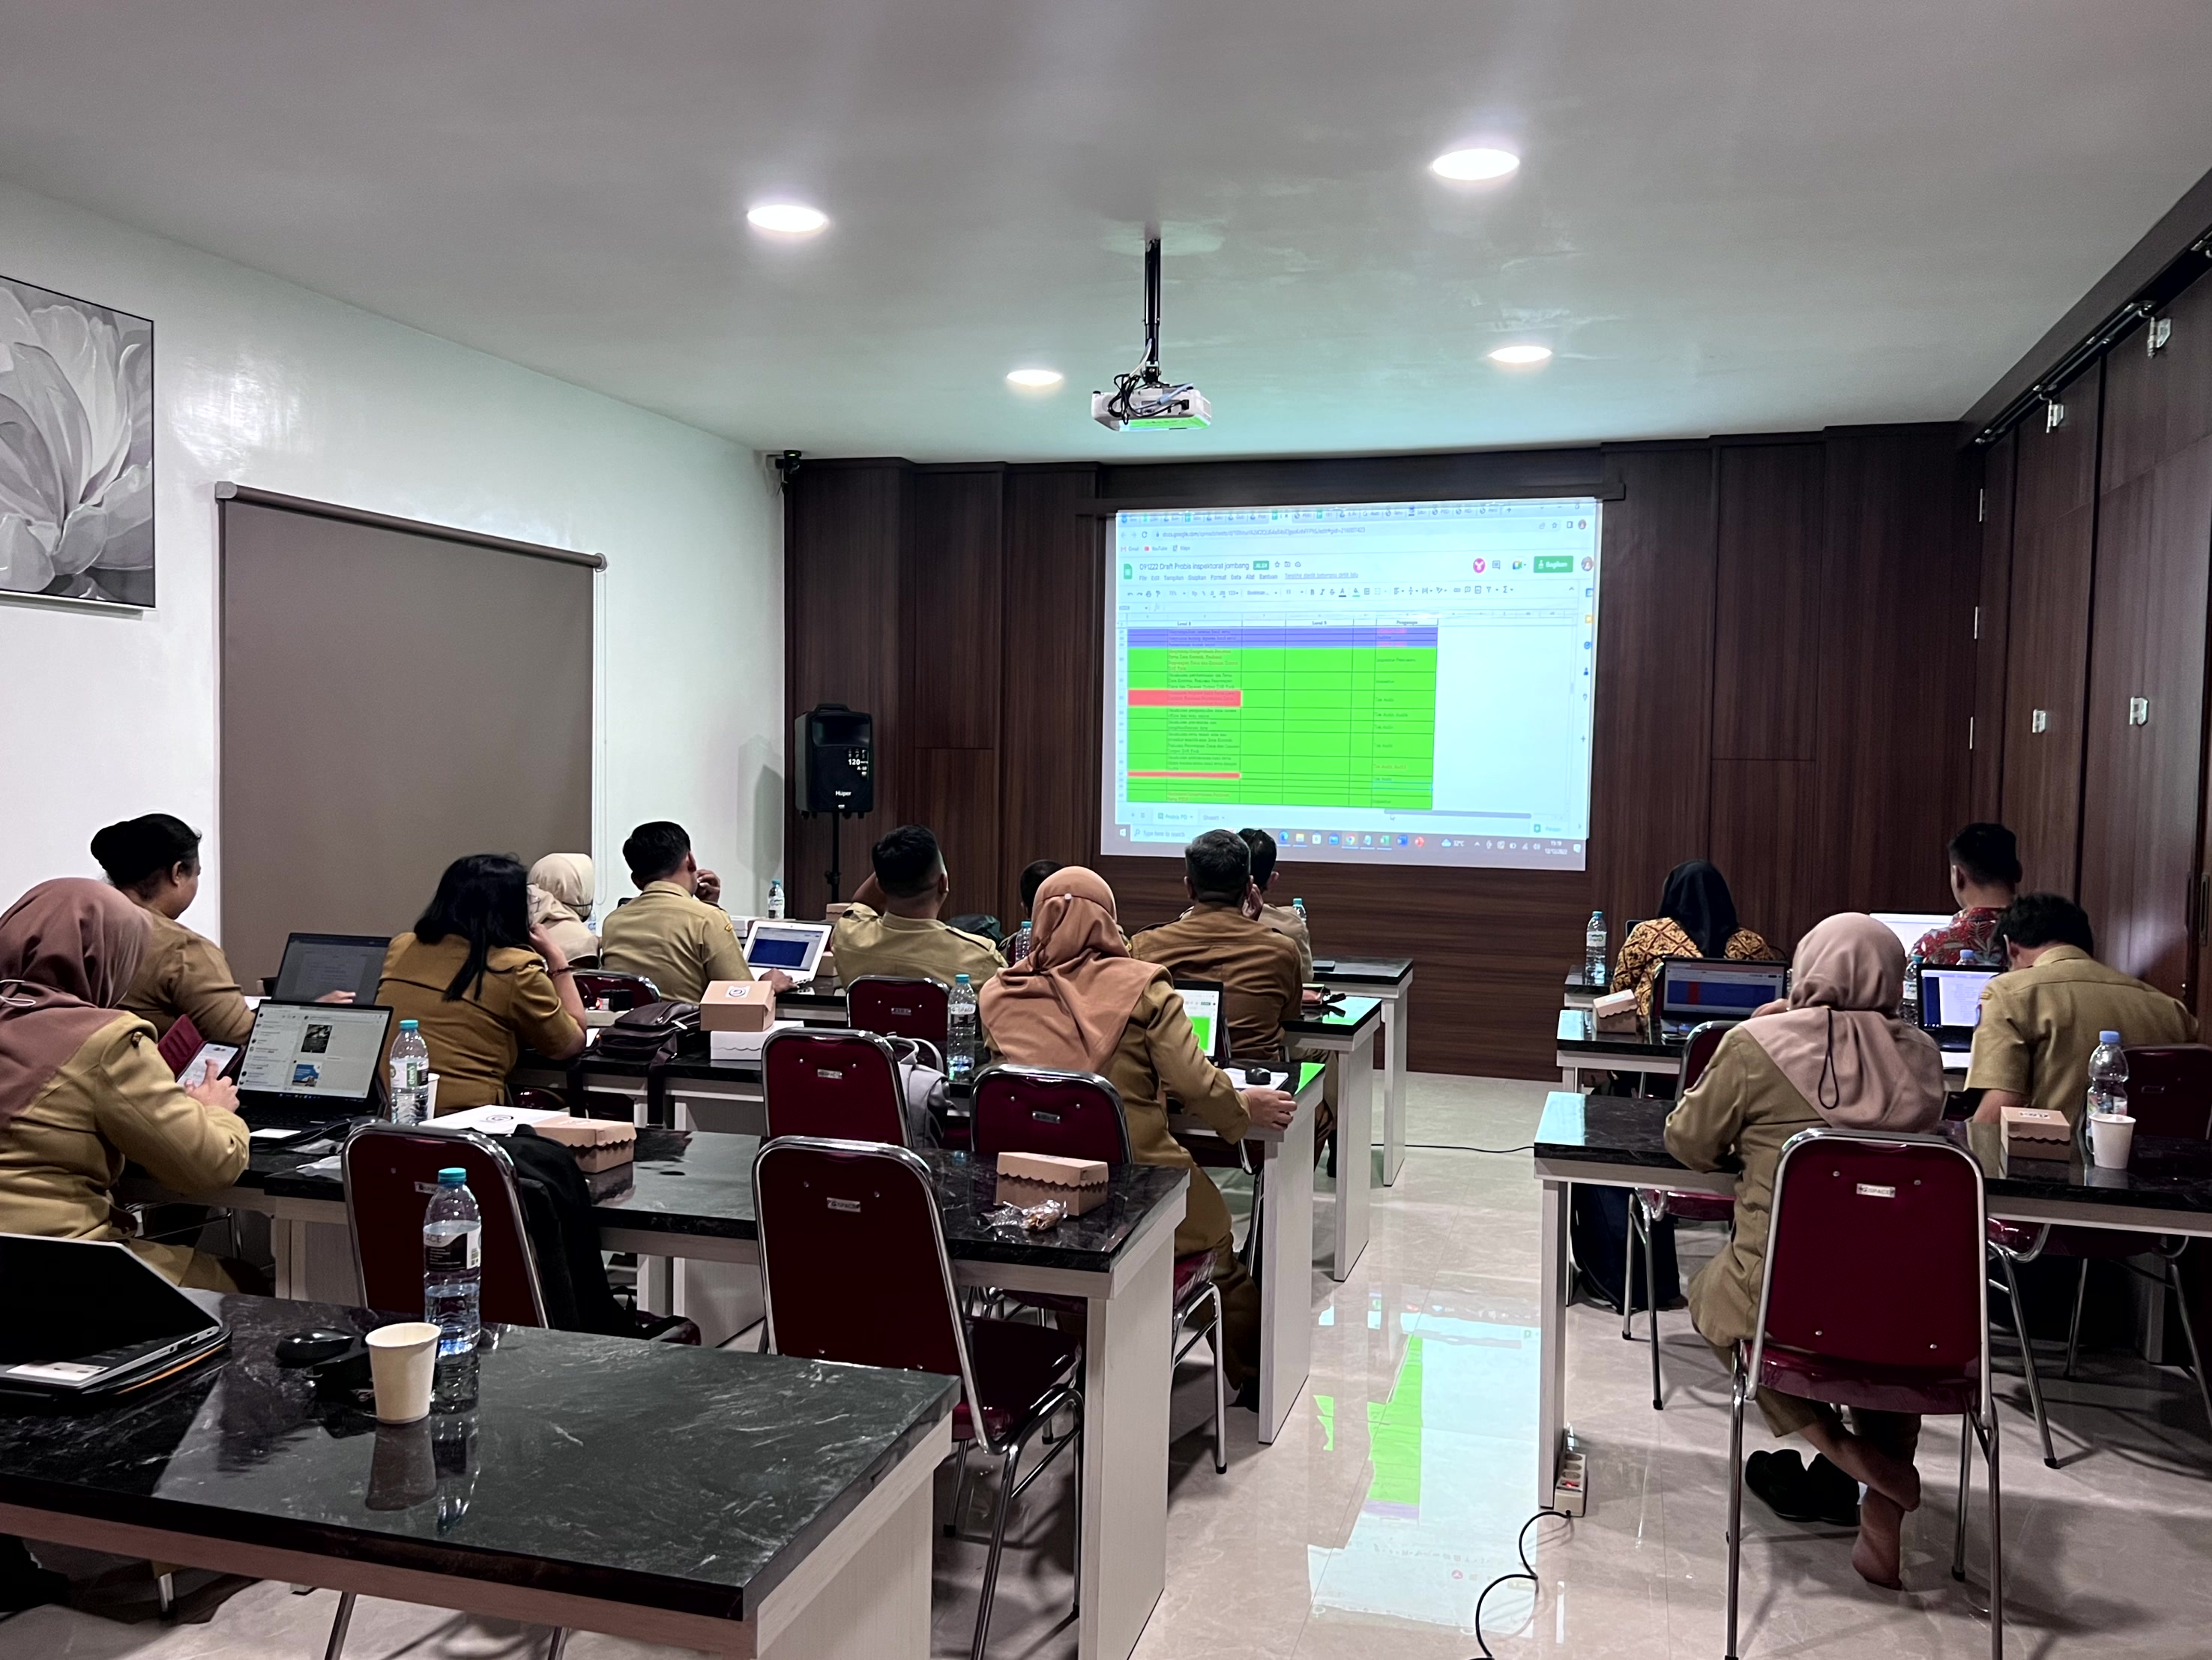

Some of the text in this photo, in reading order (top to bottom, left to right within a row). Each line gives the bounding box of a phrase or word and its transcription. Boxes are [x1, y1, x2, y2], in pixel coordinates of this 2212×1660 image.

[1160, 562, 1174, 571] Draft
[1174, 562, 1191, 571] Probis
[1193, 562, 1224, 571] inspektorat
[1223, 562, 1250, 571] jombang
[1546, 560, 1568, 570] Bagikan
